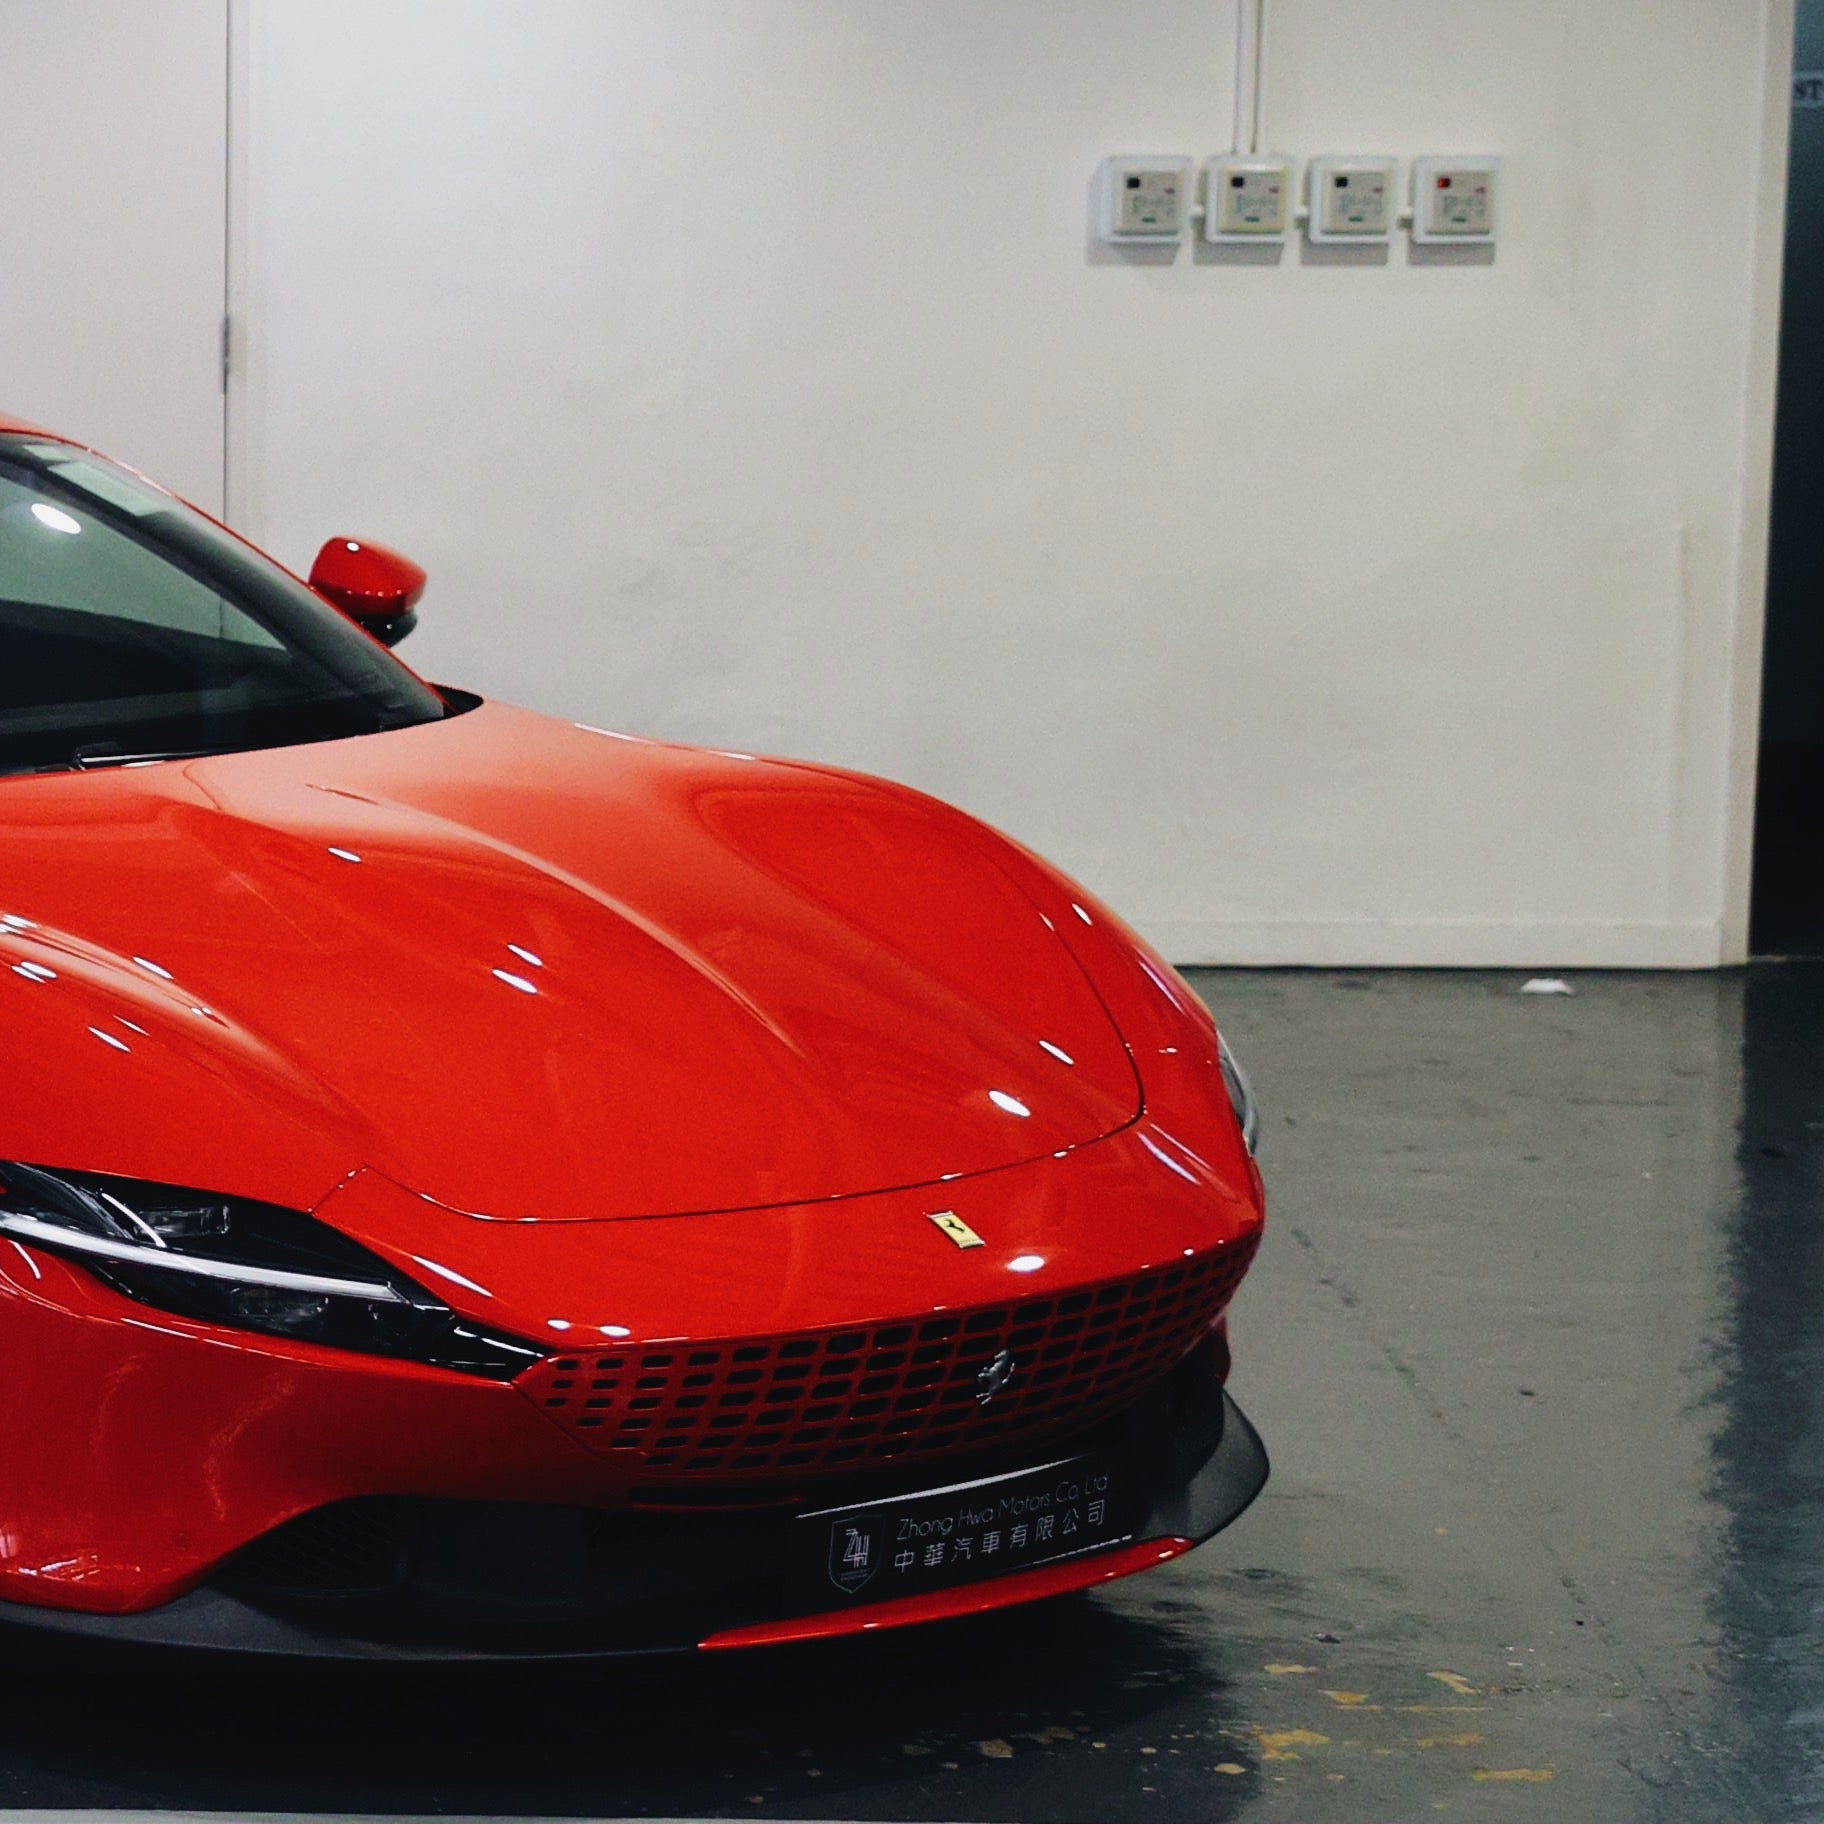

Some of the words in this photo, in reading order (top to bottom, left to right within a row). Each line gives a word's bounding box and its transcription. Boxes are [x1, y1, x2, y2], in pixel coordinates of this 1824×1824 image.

[894, 1499, 1106, 1573] 中華汽車有限公司
[895, 1516, 953, 1542] Zhong
[957, 1506, 994, 1528] Hwa
[998, 1491, 1051, 1519] Motors
